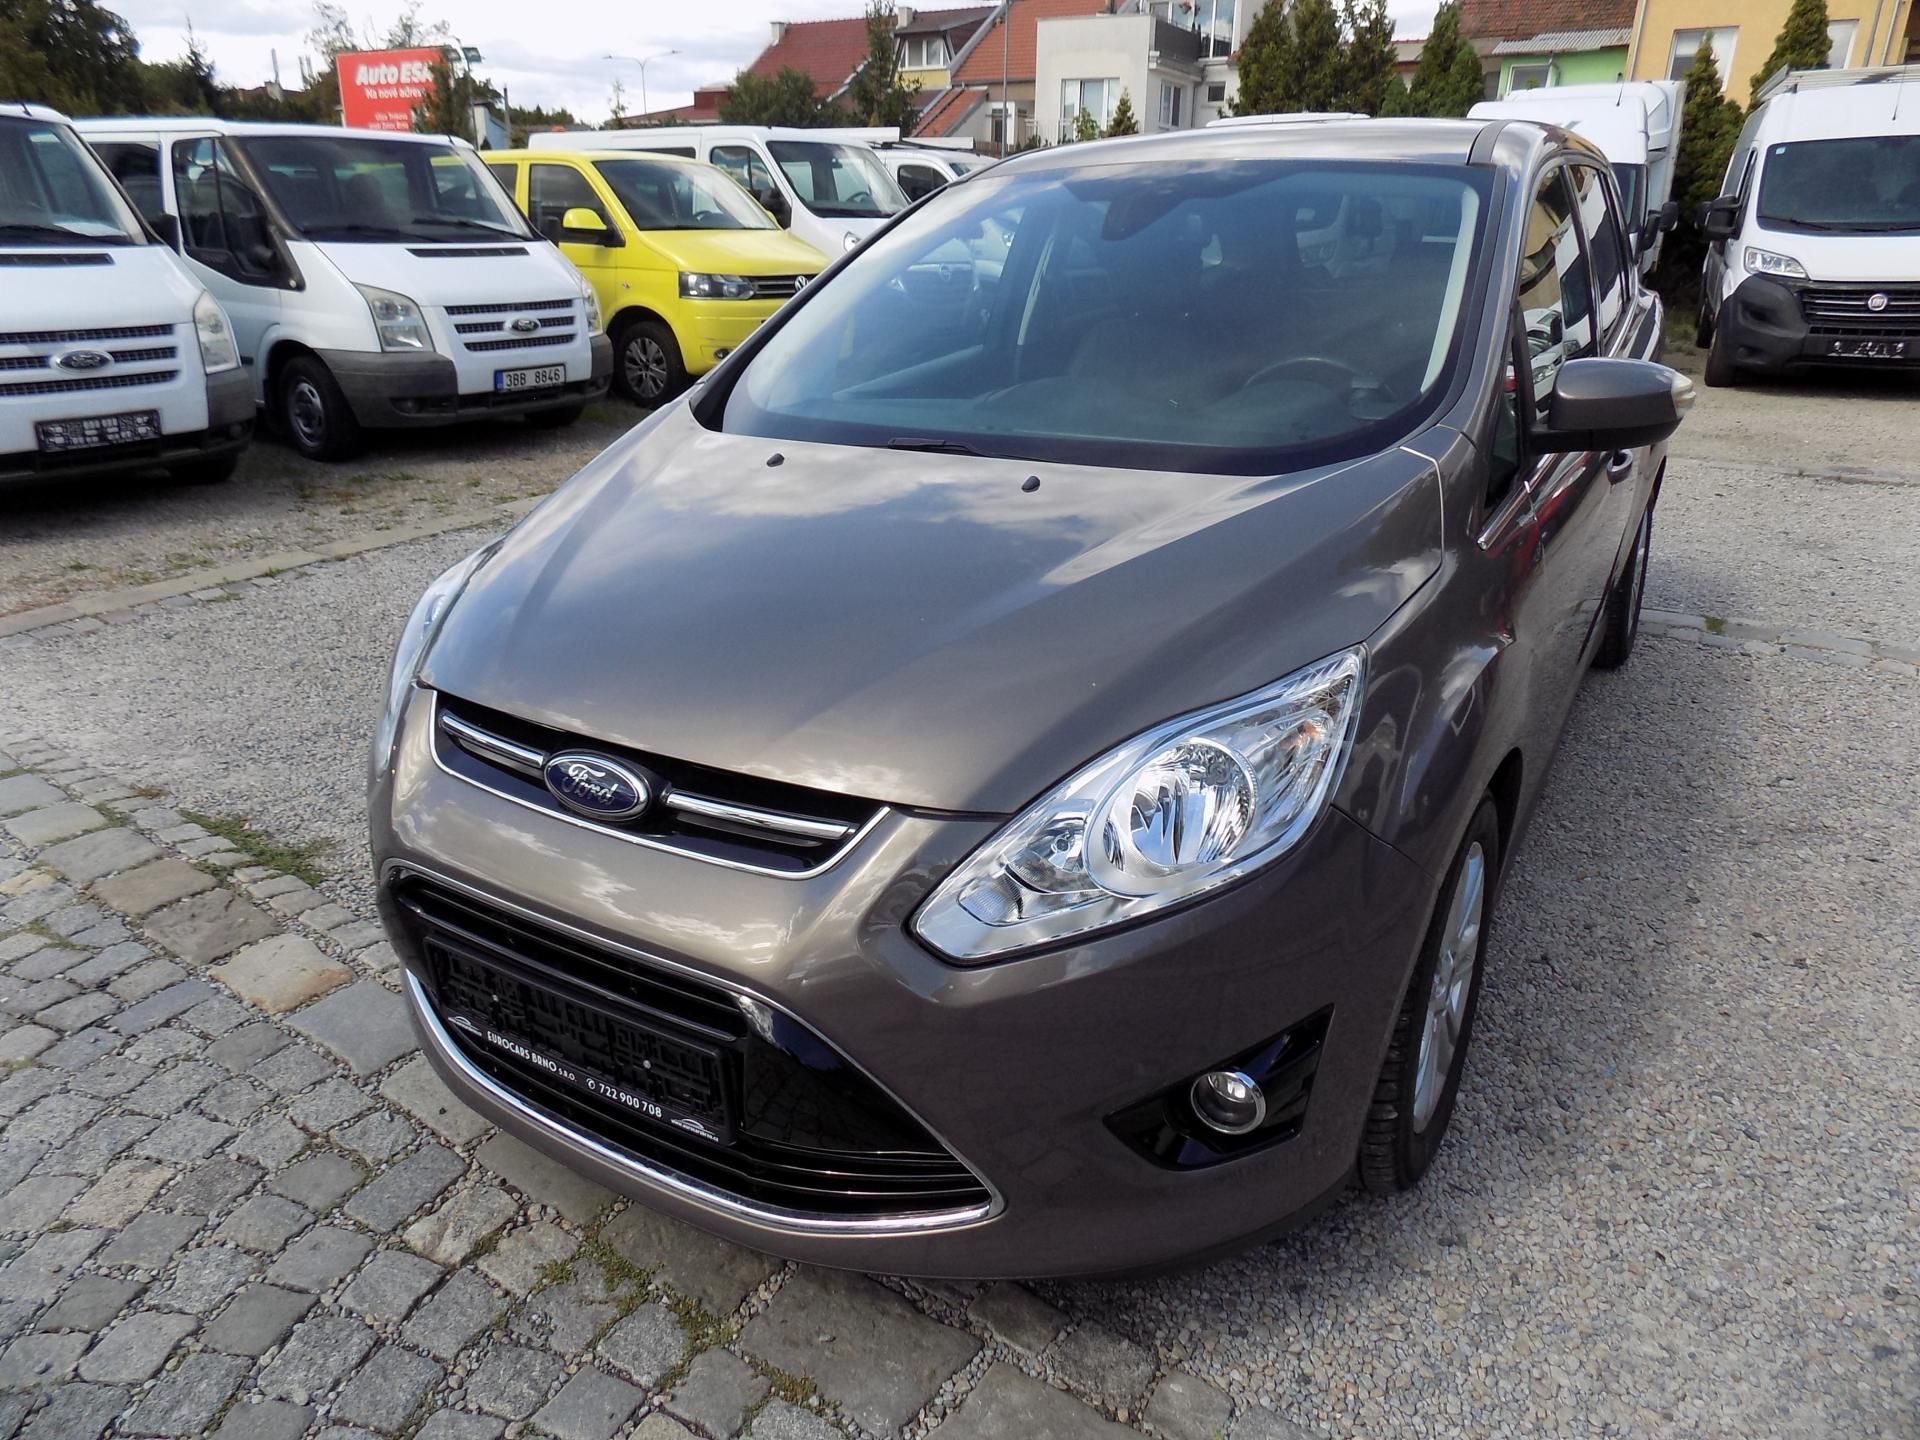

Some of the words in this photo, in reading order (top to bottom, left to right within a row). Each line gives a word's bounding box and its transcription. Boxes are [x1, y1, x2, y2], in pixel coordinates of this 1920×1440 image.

[355, 62, 398, 86] Auto
[365, 87, 378, 99] Na
[534, 368, 561, 384] 8846
[561, 763, 619, 806] Ford
[487, 1030, 530, 1060] EUROCARS
[531, 1052, 557, 1072] BRNO
[599, 1083, 618, 1100] 722
[619, 1092, 640, 1109] 900
[641, 1100, 663, 1118] 708
